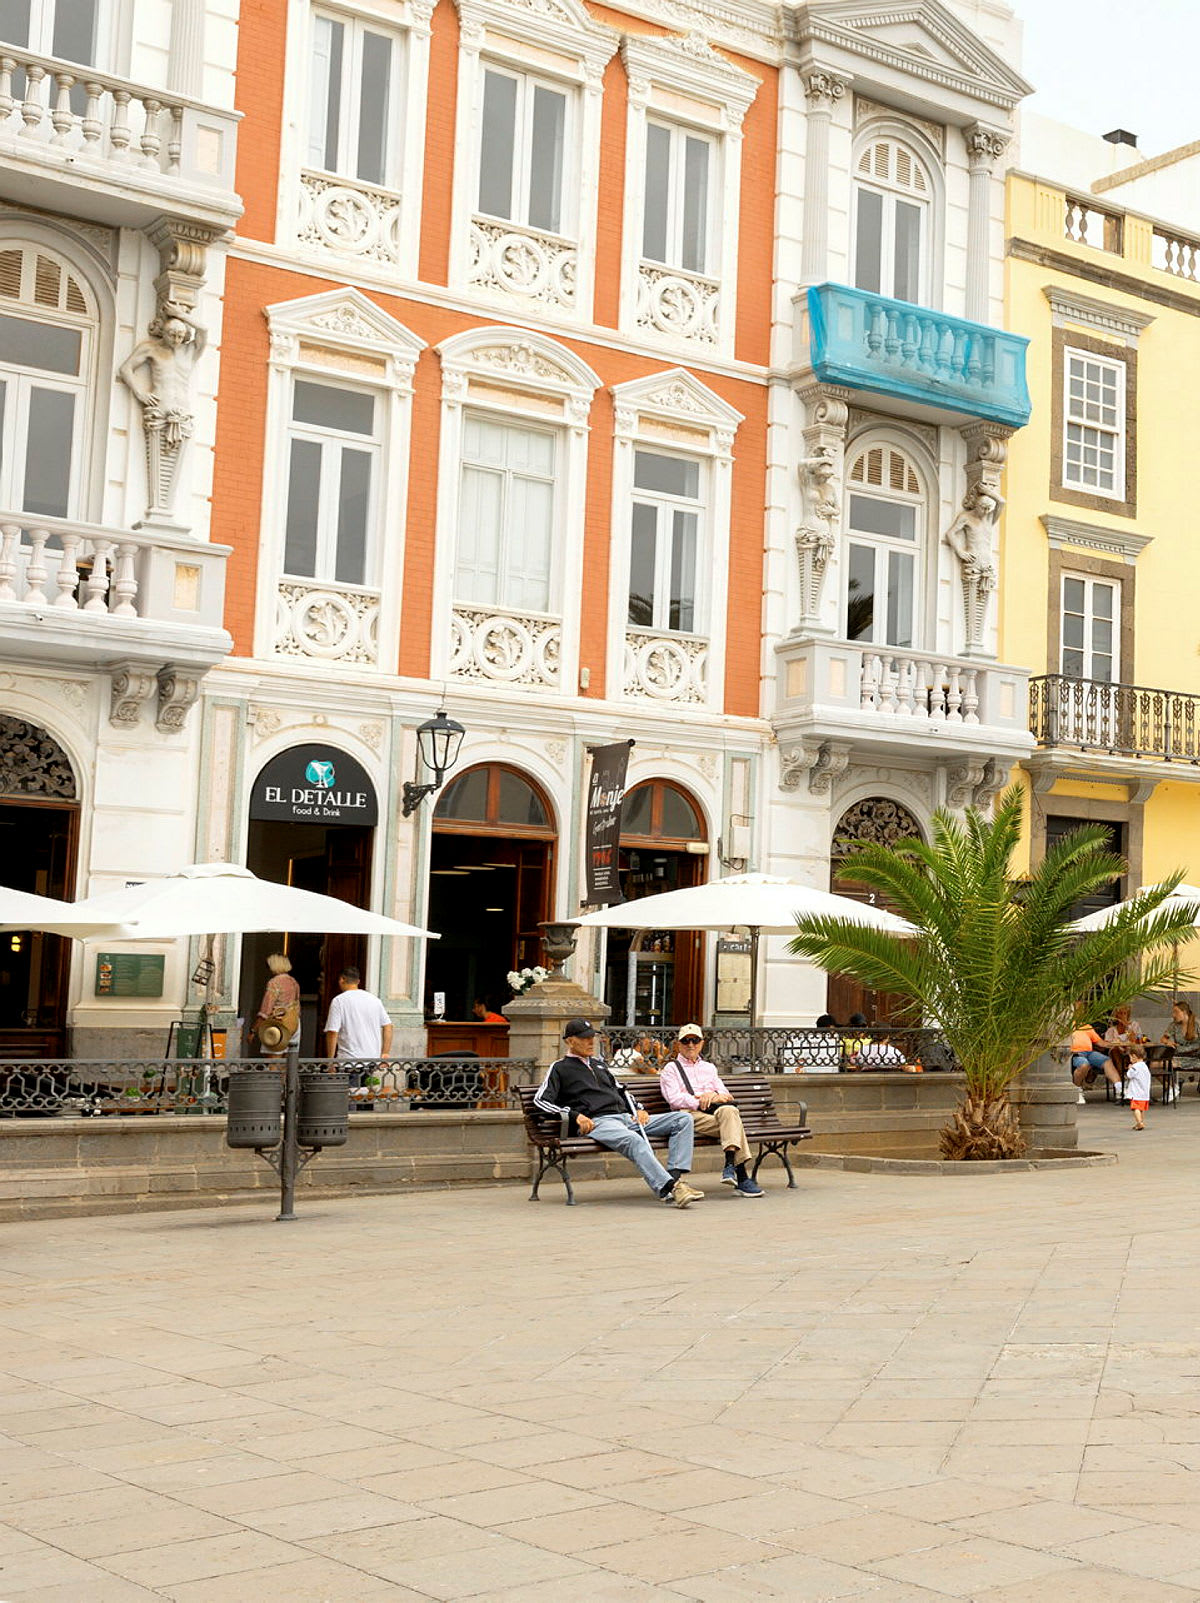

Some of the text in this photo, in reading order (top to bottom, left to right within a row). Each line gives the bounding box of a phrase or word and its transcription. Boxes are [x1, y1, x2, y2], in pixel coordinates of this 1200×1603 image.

[265, 787, 367, 808] EL DETALLE
[590, 785, 624, 812] Monje
[313, 806, 320, 816] &
[323, 807, 340, 817] Drink
[869, 893, 875, 904] 2
